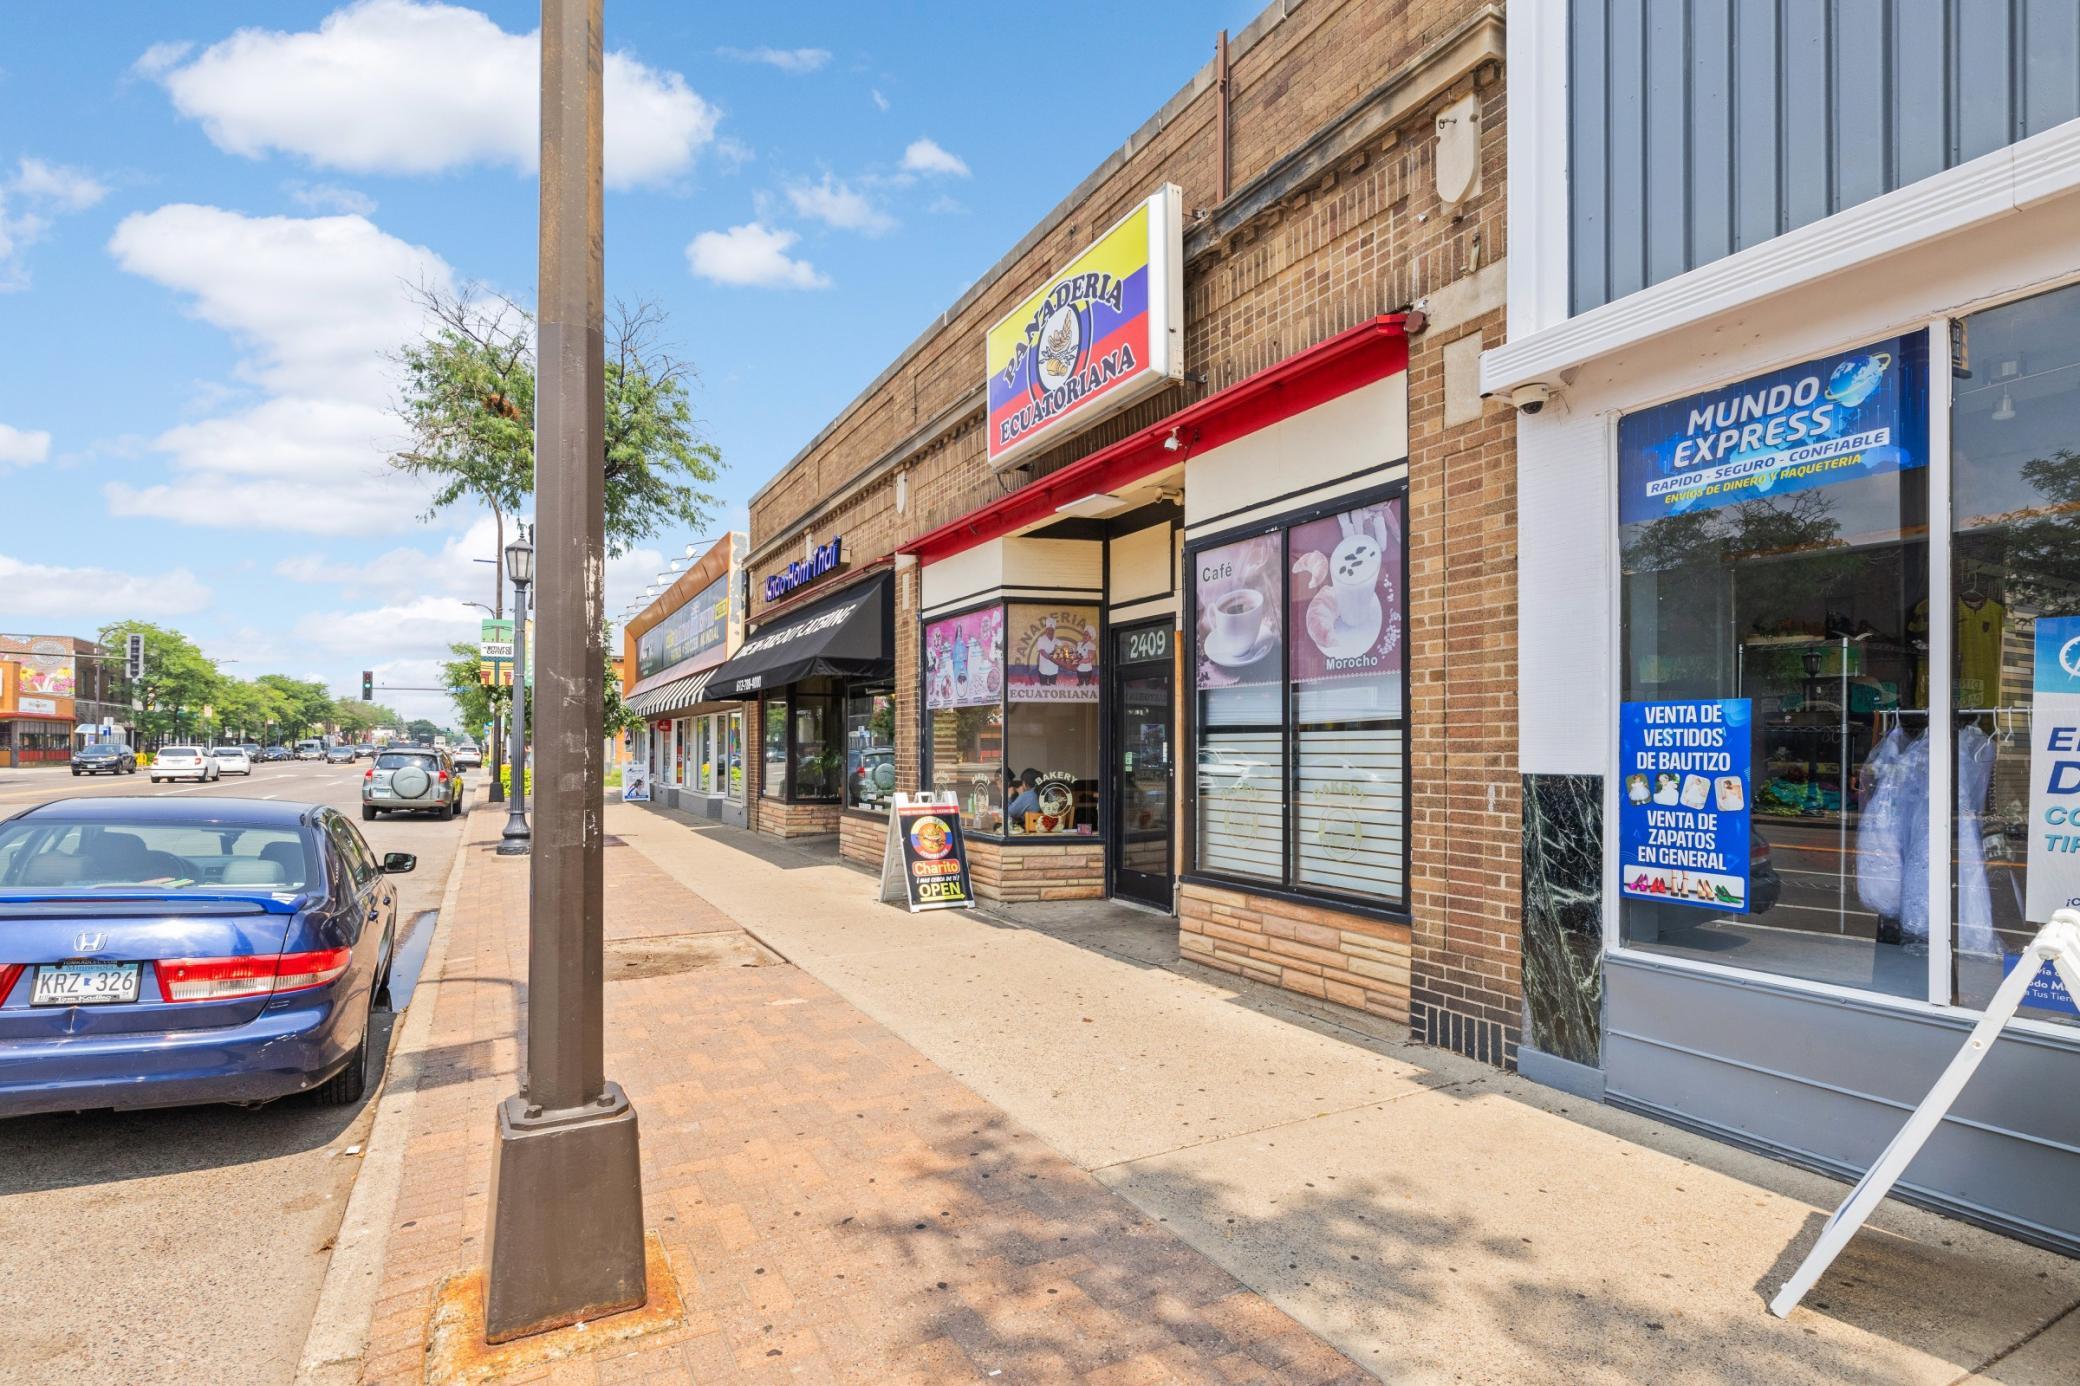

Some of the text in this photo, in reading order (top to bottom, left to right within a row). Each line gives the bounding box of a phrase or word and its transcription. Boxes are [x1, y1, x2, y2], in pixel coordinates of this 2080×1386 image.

[1003, 272, 1122, 387] PANADERIA
[1000, 345, 1135, 444] ECUATORIANA
[1688, 376, 1820, 436] MUNDO
[1673, 404, 1833, 467] EXPRESS
[1650, 473, 1702, 494] RAPIDO
[1714, 456, 1776, 479] SEGURO
[1788, 431, 1886, 463] CONFIABLE
[1705, 484, 1720, 496] DE
[1723, 474, 1766, 493] DINERO
[1780, 454, 1862, 481] PAQUETERIA
[787, 562, 814, 590] Hom
[813, 536, 841, 577] Thai
[1202, 561, 1233, 583] Café
[1129, 630, 1166, 658] 2409
[1325, 655, 1379, 671] Morocho
[1009, 689, 1098, 699] ECUATORIANA
[1645, 704, 1722, 724] VENTA DE
[1643, 728, 1724, 748] VESTIDOS
[1636, 752, 1731, 772] DE BAUTIZO
[1034, 771, 1078, 785] BAKERY
[1647, 810, 1718, 831] VENTA DE
[1648, 828, 1716, 850] ZAPATOS
[914, 861, 959, 875] Charito
[1637, 845, 1727, 871] EN GENERAL
[919, 881, 961, 897] OPEN
[40, 971, 133, 994] KRZ 326
